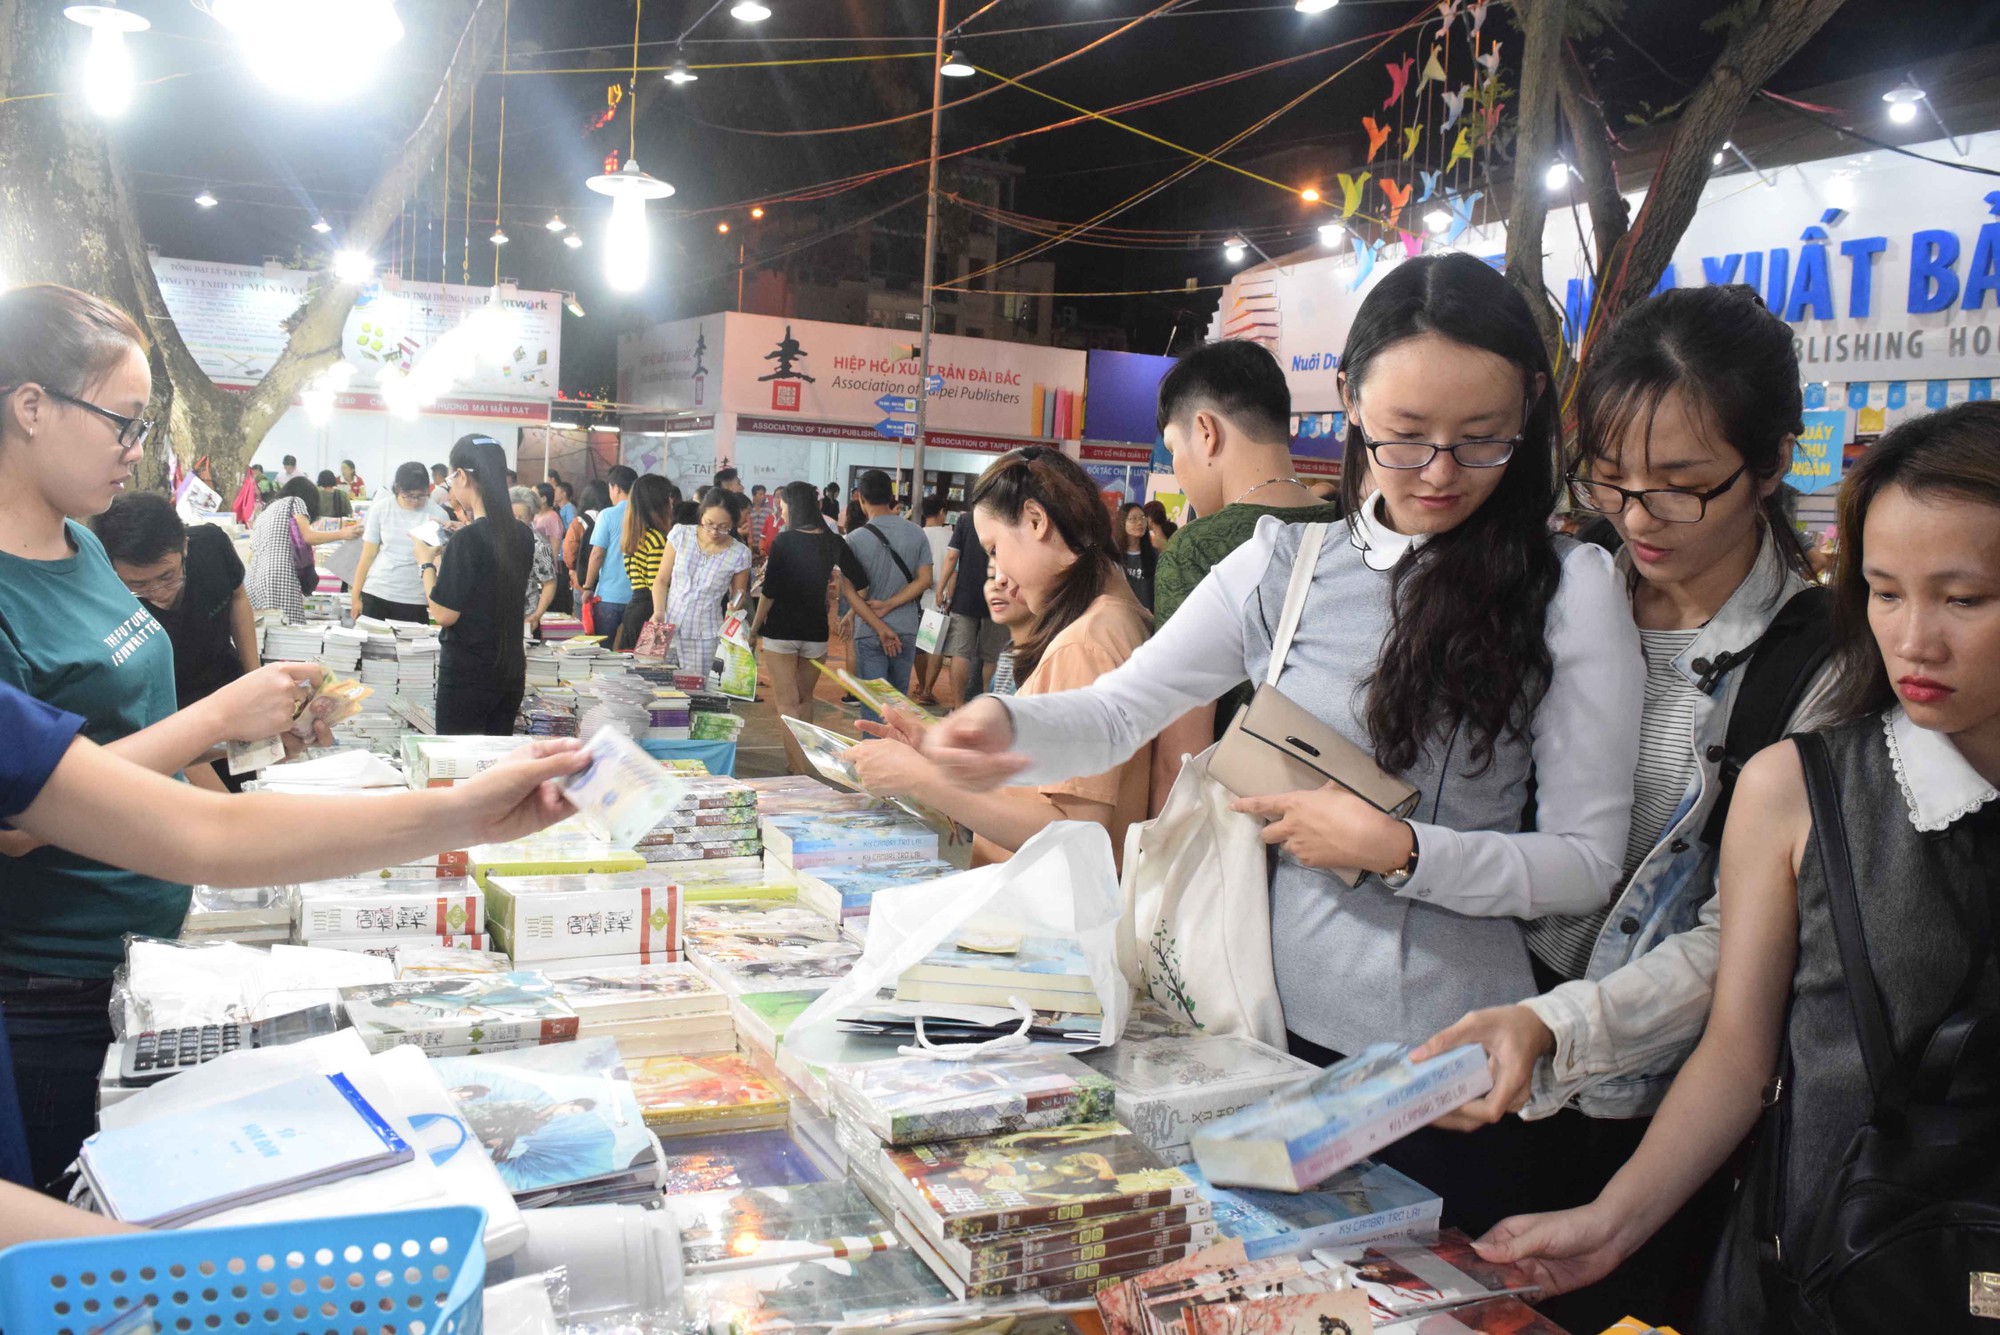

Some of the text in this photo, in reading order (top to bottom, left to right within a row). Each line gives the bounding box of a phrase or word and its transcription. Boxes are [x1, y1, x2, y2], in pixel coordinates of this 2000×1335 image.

[1794, 329, 1923, 364] BLISHING
[834, 355, 866, 373] HIỆP
[869, 359, 895, 376] HỘI
[898, 362, 934, 377] XUT
[938, 363, 965, 382] BẢN
[968, 366, 992, 383] ĐÀI
[832, 375, 905, 394] Association
[907, 383, 920, 395] of
[961, 386, 1020, 406] Publishers
[752, 422, 803, 433] ASSOCIATION
[805, 425, 816, 433] OF
[818, 426, 841, 436] TAIPEI
[932, 437, 978, 448] ASSOCIATION
[990, 442, 1011, 450] TAIPEI
[114, 607, 149, 641] FUTURE
